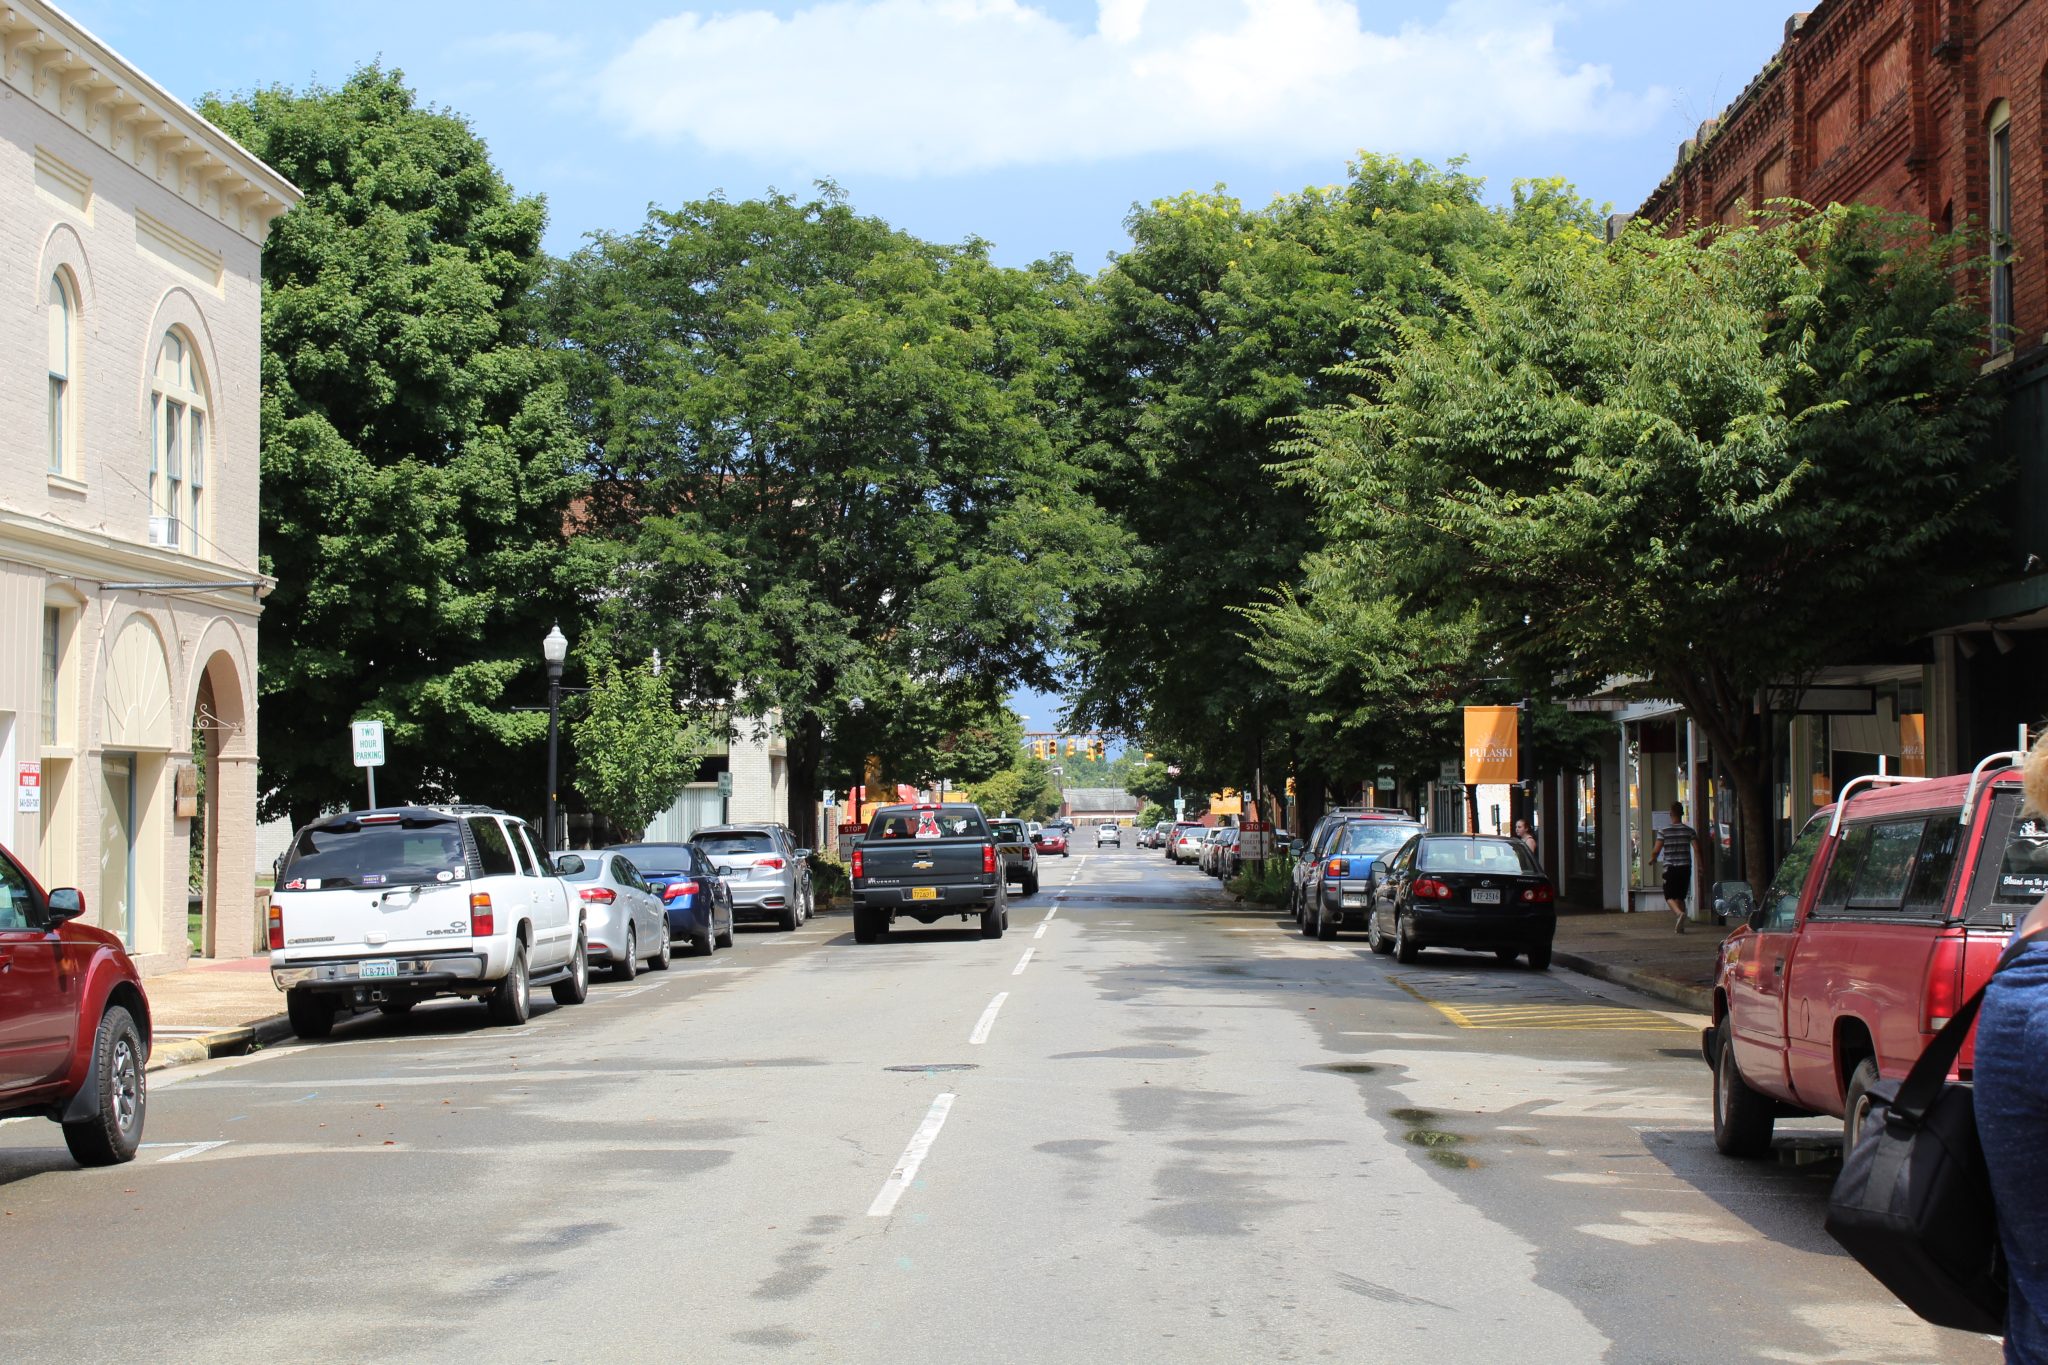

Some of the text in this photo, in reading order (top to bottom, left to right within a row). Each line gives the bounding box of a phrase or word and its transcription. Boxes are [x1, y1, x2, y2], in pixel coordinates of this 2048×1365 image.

[361, 728, 375, 736] TWO
[360, 740, 376, 748] HOUR
[356, 751, 381, 760] PARKING
[1469, 747, 1512, 758] PULASKI
[844, 825, 861, 833] STOP
[2003, 876, 2023, 885] Blessed
[426, 928, 467, 936] CHEVROLET
